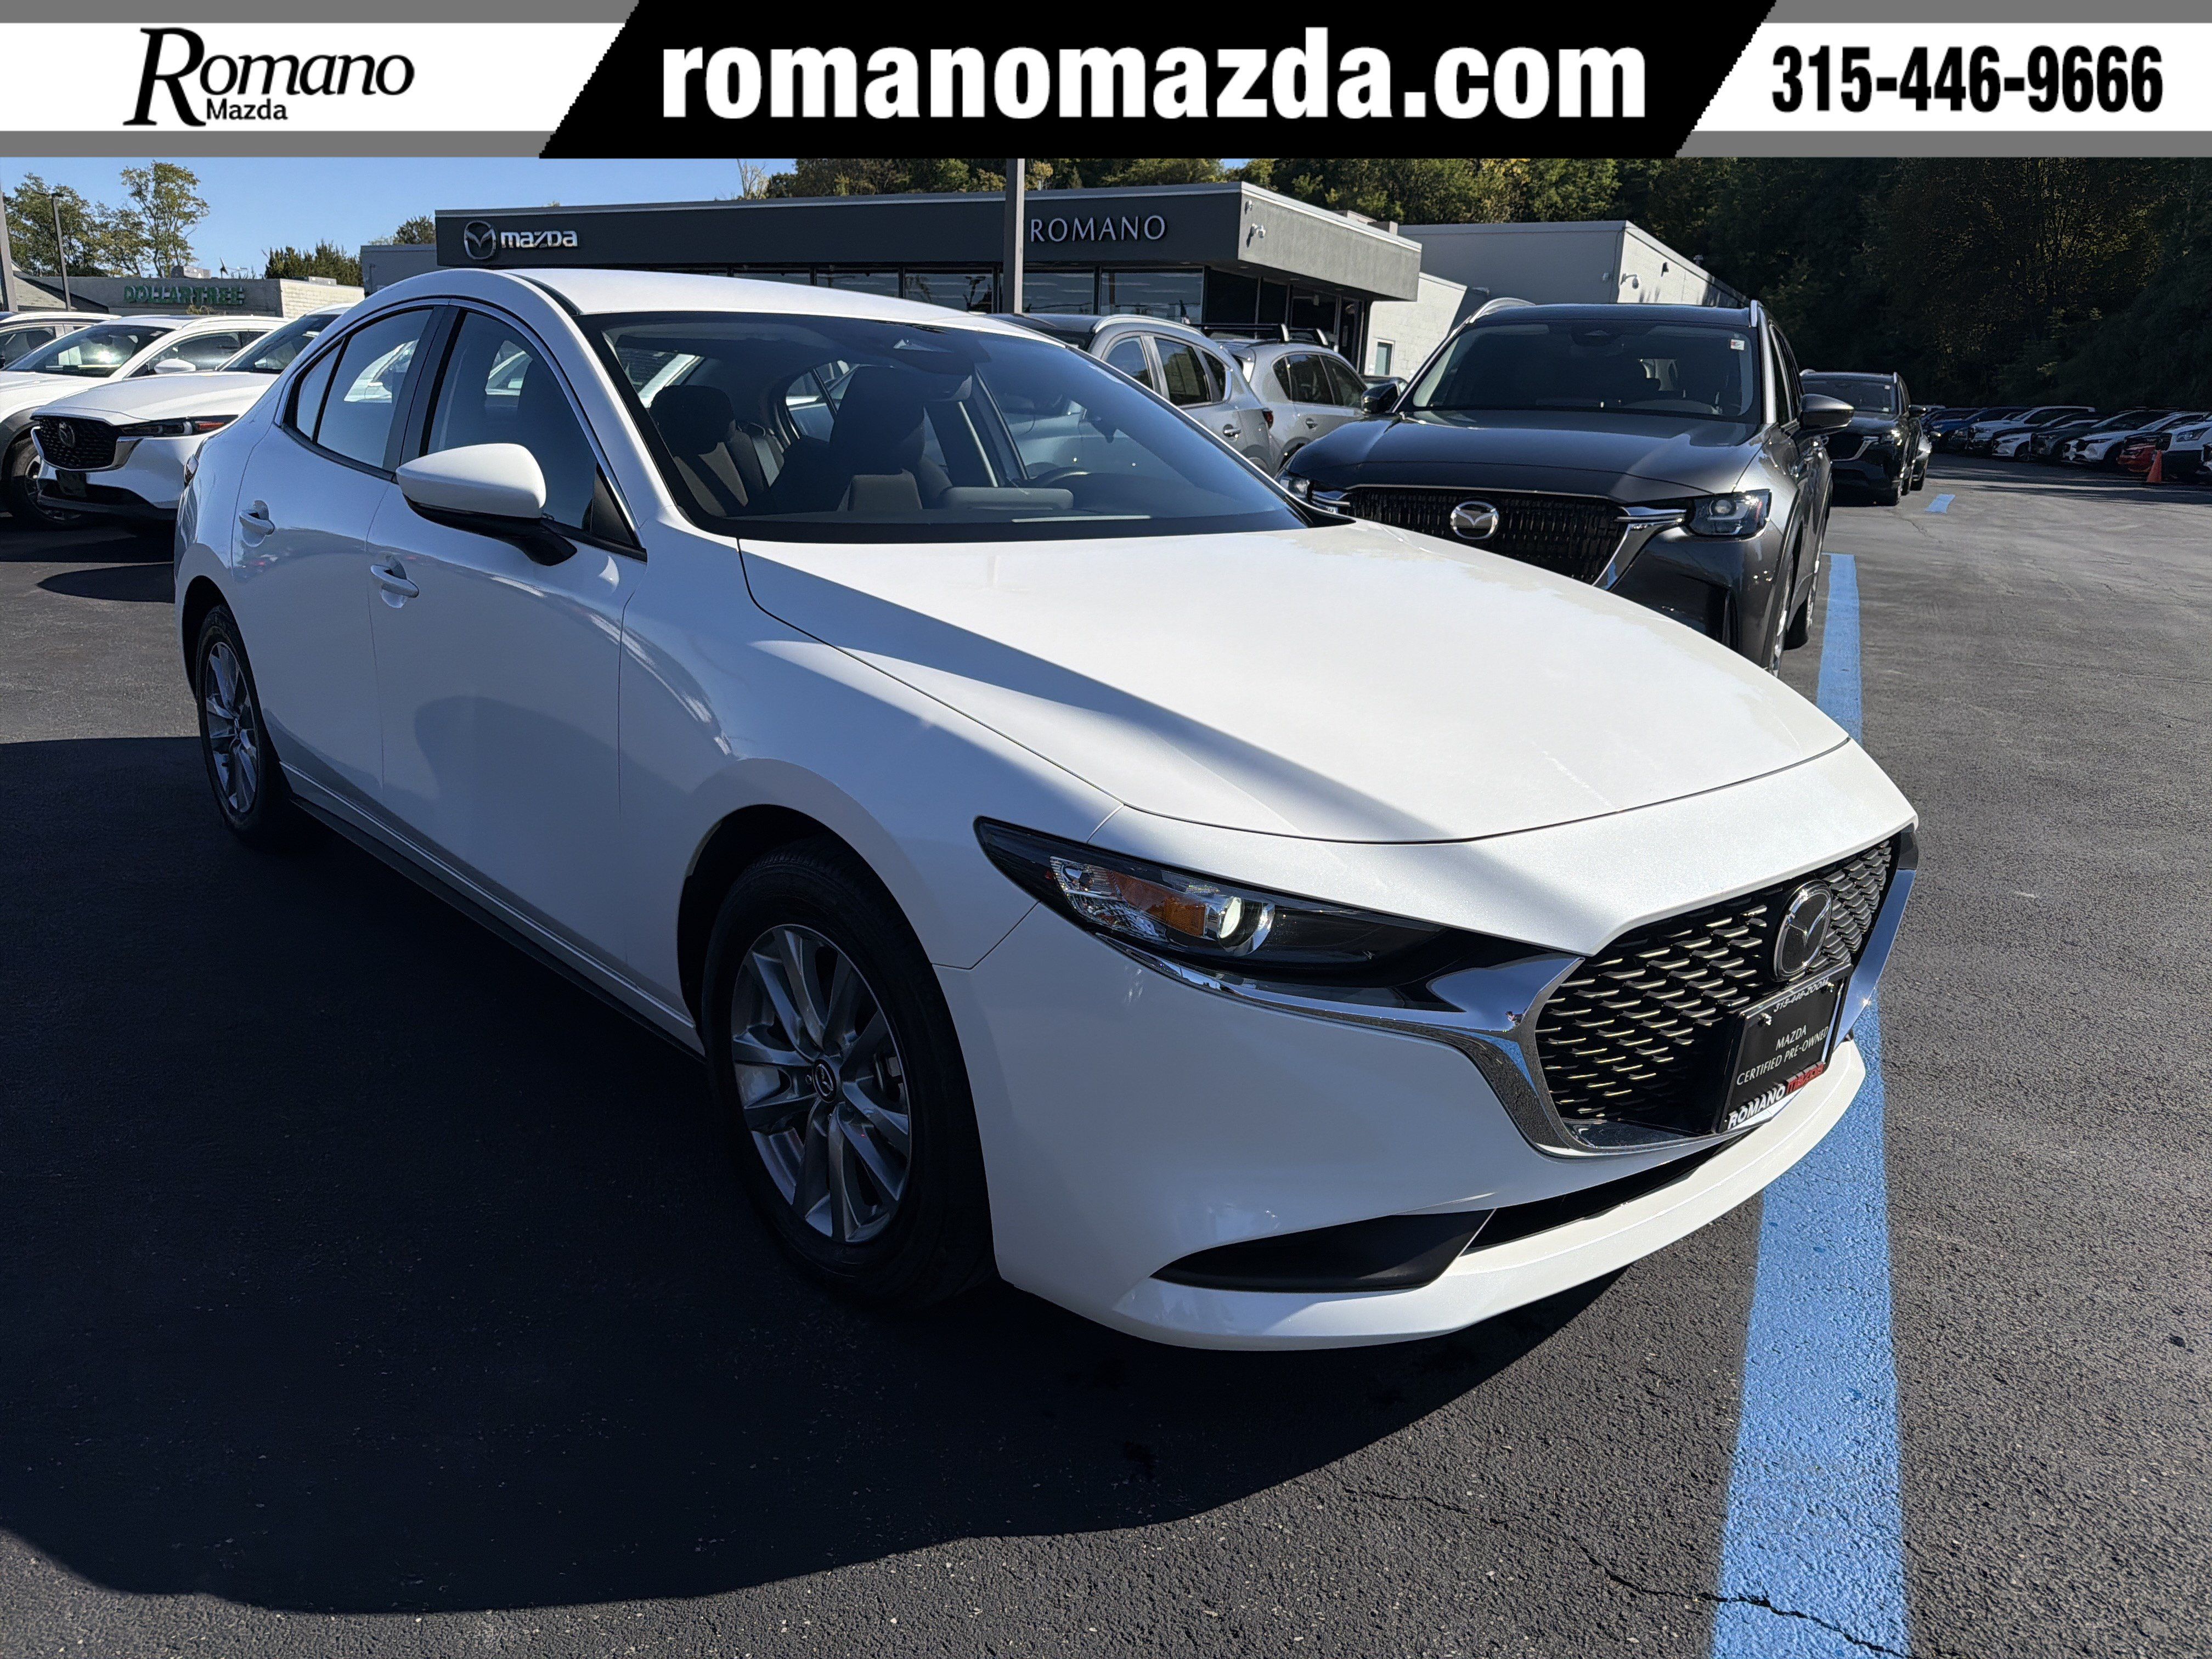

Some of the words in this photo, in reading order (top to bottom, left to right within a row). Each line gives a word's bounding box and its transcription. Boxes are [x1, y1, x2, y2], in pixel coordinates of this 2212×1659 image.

[1030, 215, 1166, 242] ROMANO
[1736, 1054, 1782, 1086] CERTIFIED
[1784, 1026, 1829, 1063] PRE-OWNED
[1775, 1025, 1807, 1051] MAZDA
[1727, 1082, 1786, 1130] ROMANO
